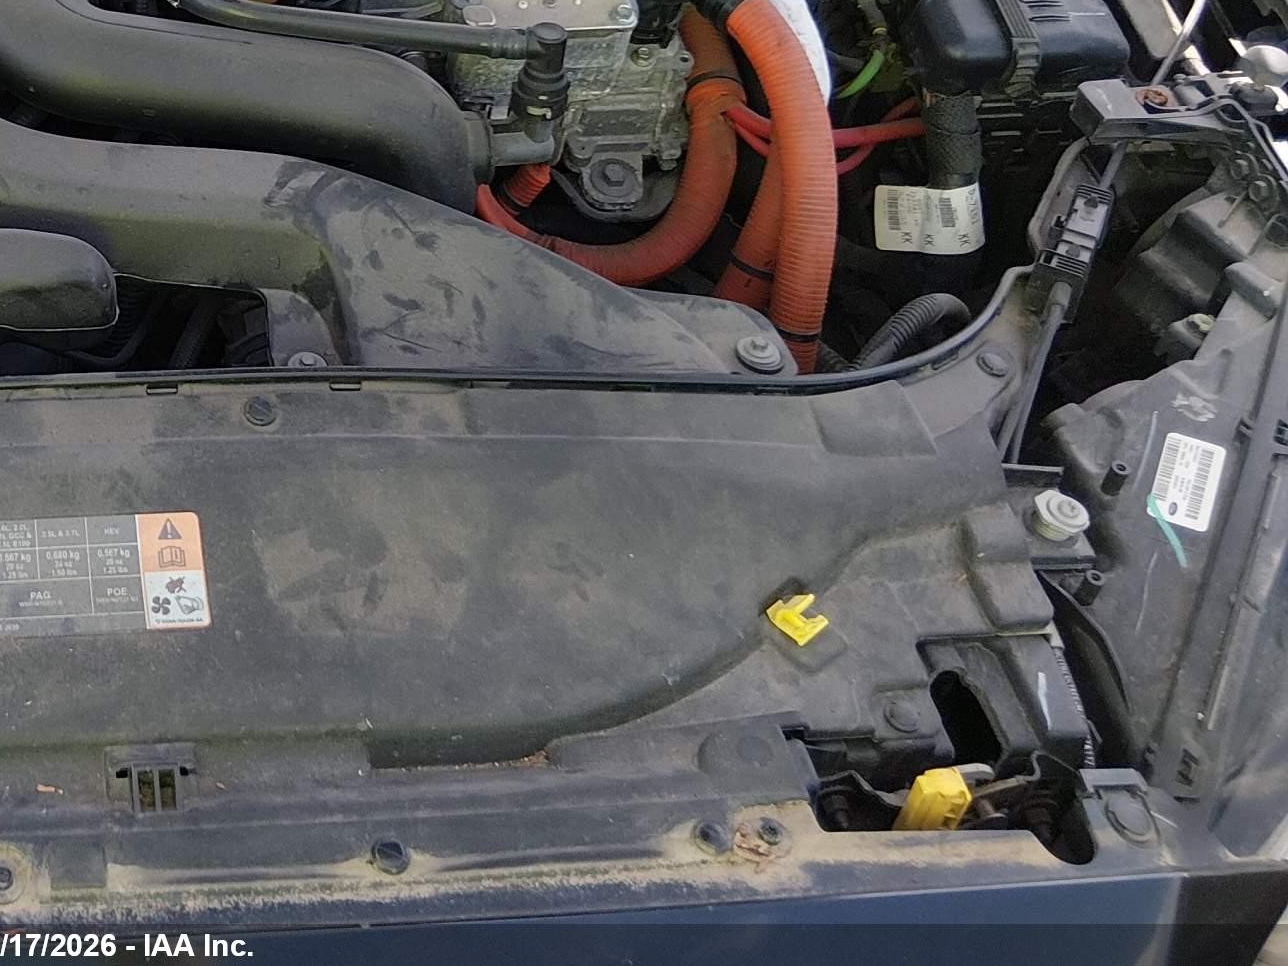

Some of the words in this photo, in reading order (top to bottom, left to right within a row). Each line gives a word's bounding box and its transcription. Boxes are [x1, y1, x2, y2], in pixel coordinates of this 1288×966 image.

[20, 552, 31, 563] kg
[69, 549, 80, 561] kg
[120, 546, 130, 558] kg
[30, 591, 51, 601] PAG
[107, 587, 128, 596] POE
